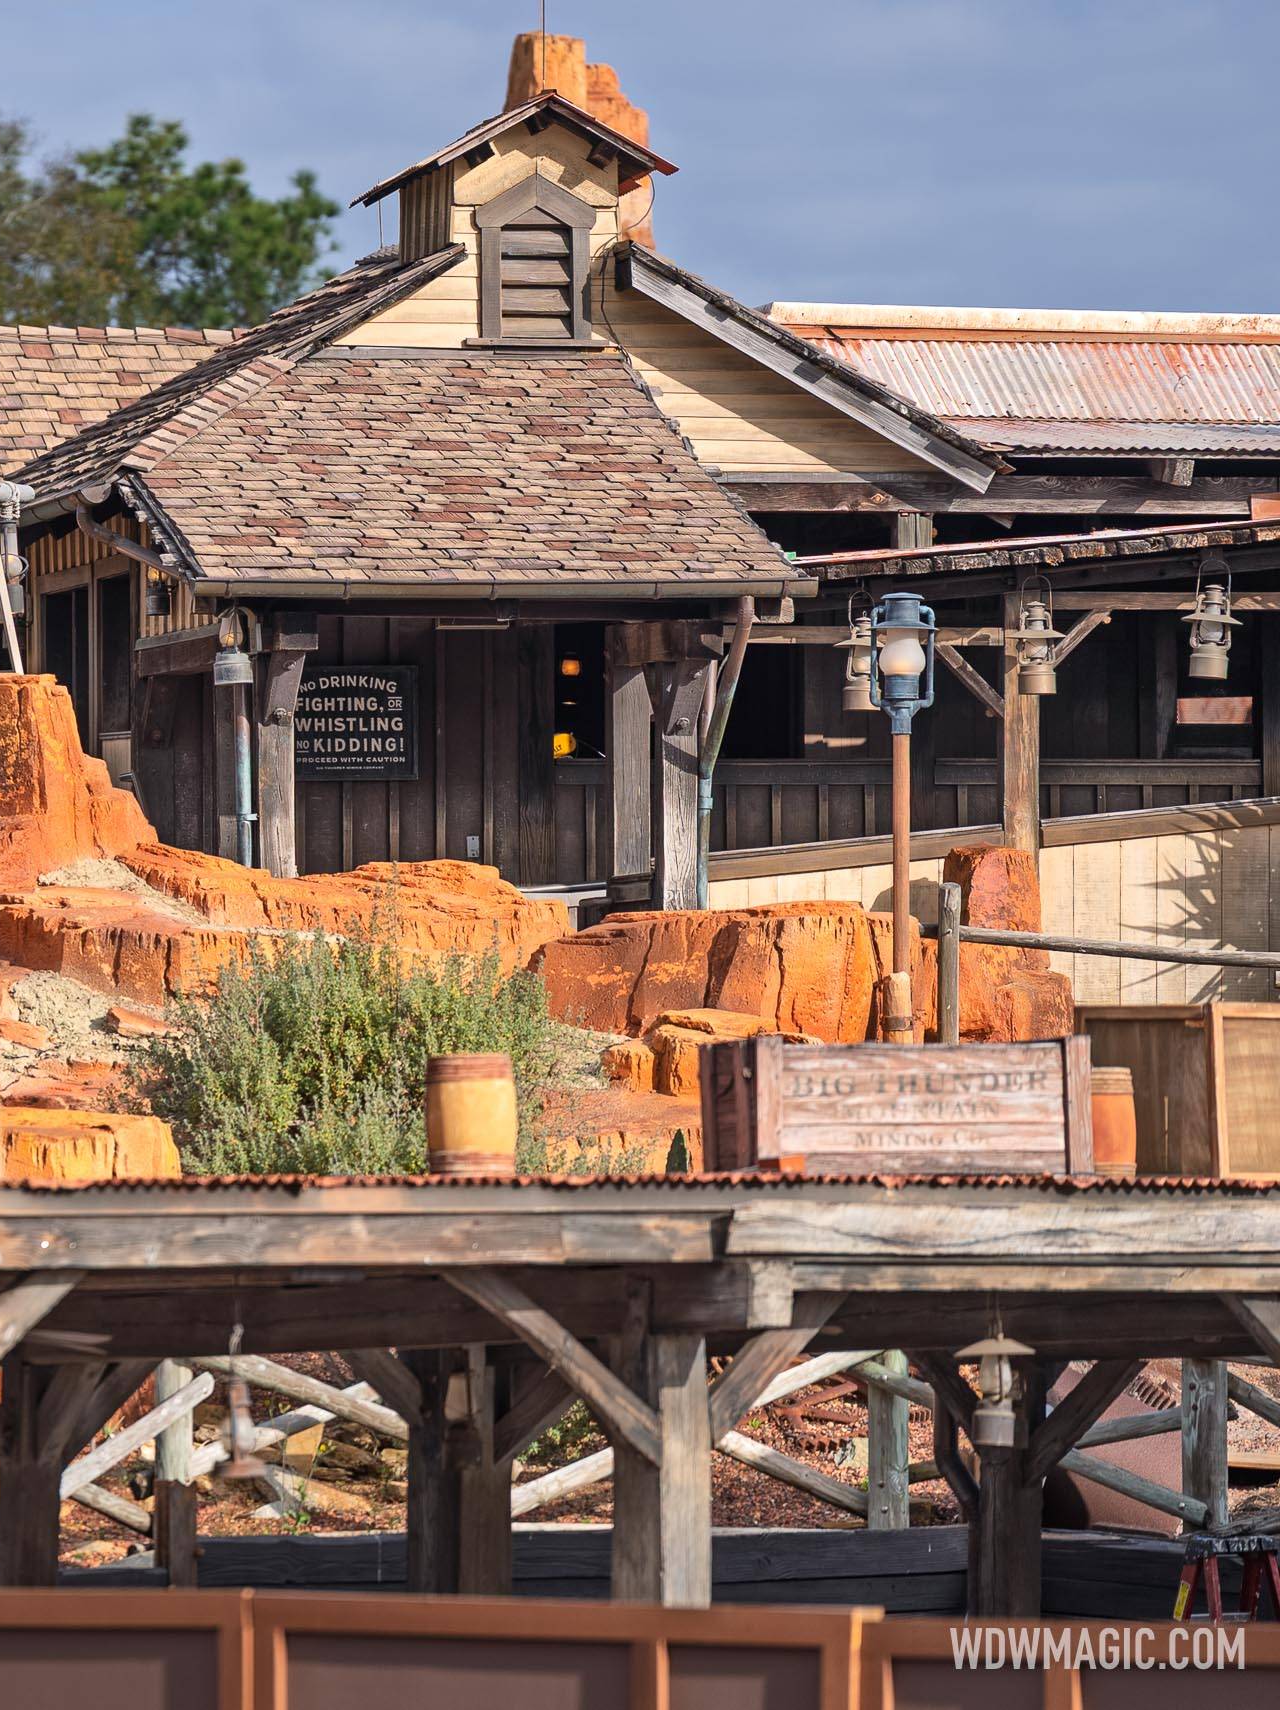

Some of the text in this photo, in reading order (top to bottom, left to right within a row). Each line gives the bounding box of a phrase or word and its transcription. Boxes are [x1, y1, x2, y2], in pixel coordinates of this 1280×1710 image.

[300, 675, 397, 693] NO DRINKING
[295, 697, 402, 713] FIGHTING, OR
[295, 718, 404, 731] WHISTLING
[296, 737, 404, 752] NO KIDDING!
[793, 1071, 1048, 1097] BIG THUNDER
[854, 1133, 943, 1148] MINING
